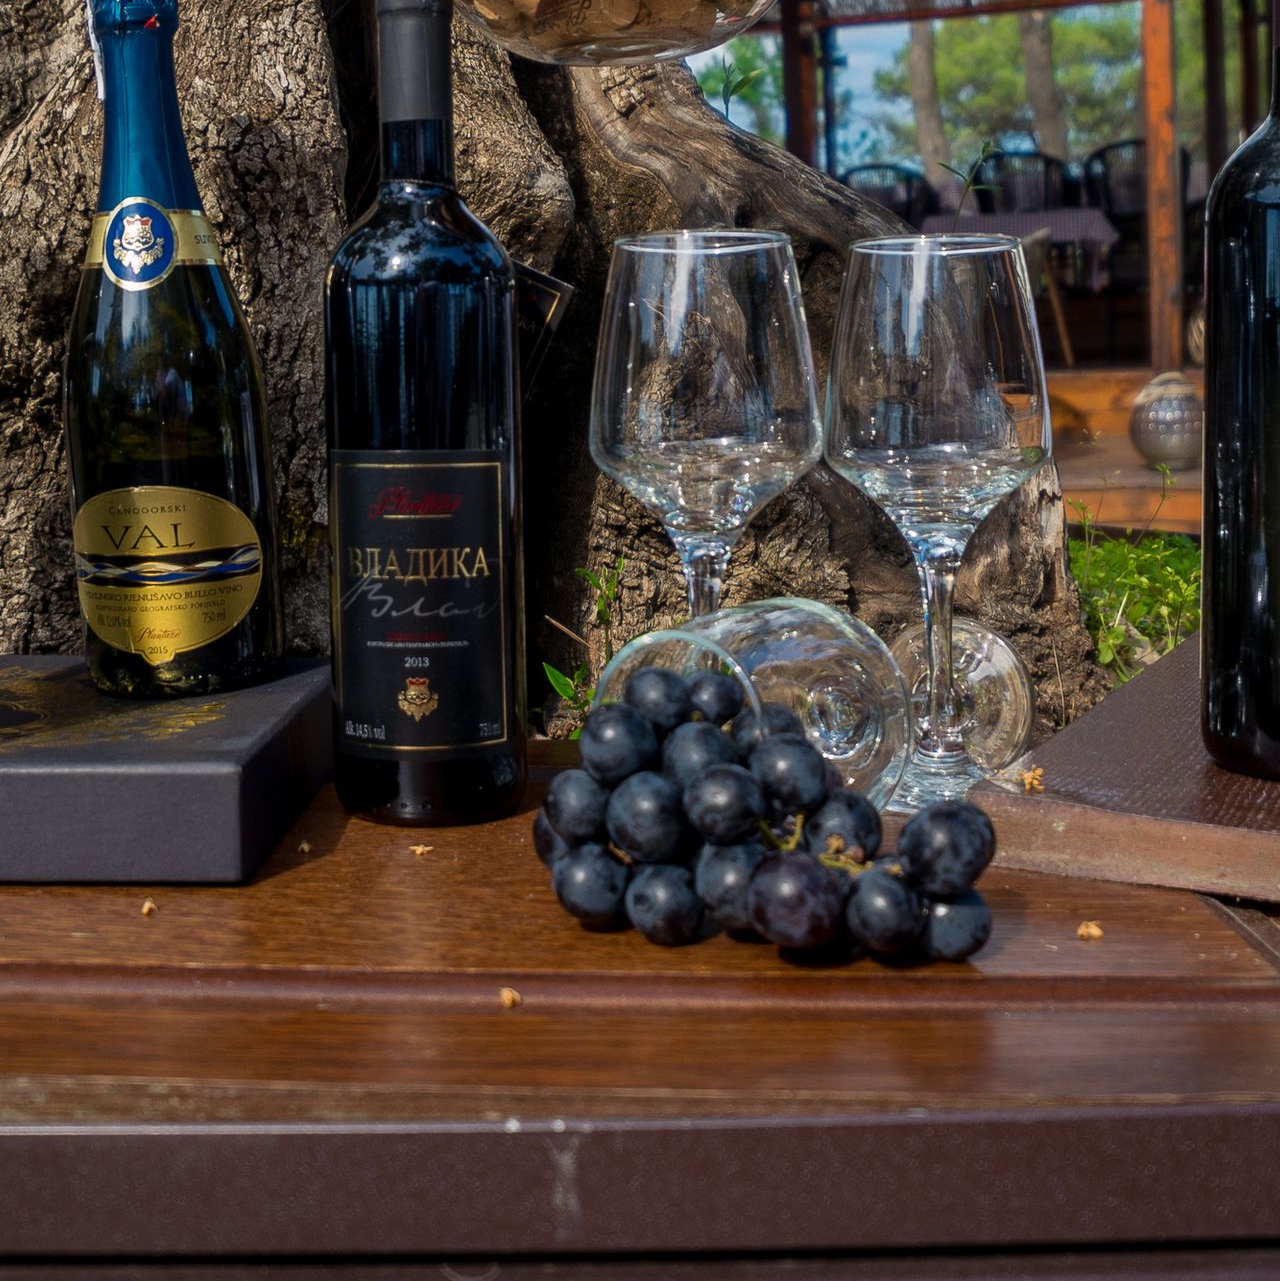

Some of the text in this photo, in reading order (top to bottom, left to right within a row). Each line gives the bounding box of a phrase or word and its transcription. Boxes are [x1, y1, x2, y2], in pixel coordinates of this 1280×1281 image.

[102, 522, 197, 551] VAL
[348, 546, 491, 587] ВЛАДИКА
[219, 584, 243, 595] VINO
[149, 646, 169, 655] 2015
[404, 656, 430, 668] 2013
